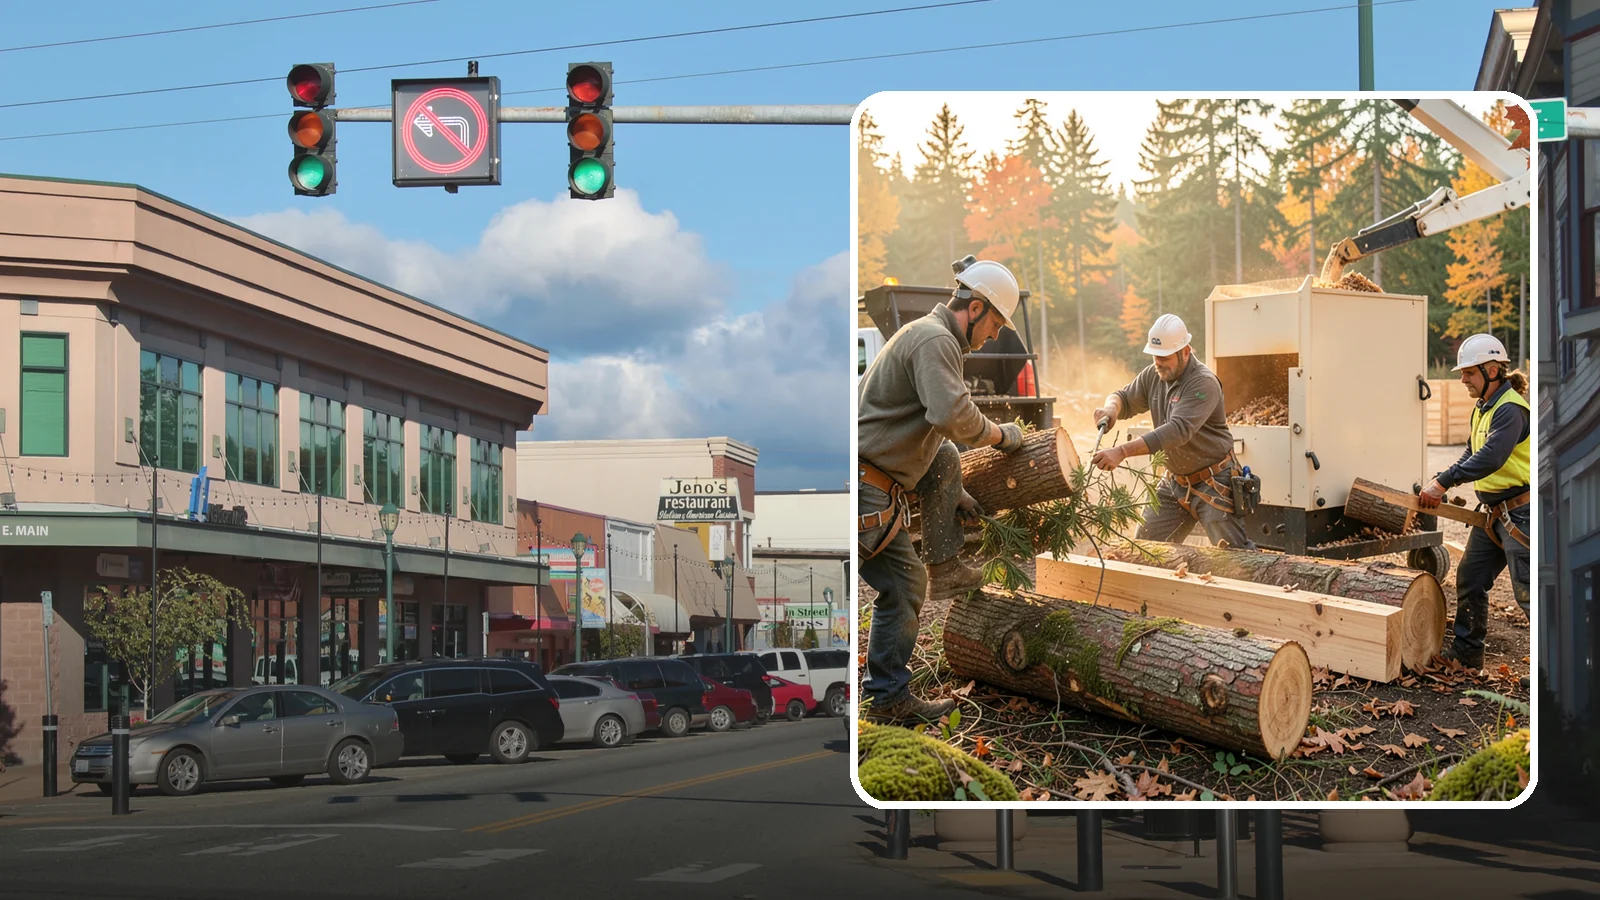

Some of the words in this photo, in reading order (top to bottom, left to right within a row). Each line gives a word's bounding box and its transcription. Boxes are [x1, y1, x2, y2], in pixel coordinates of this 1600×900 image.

[670, 480, 728, 494] Jeno's
[665, 496, 731, 509] restaurant
[658, 510, 681, 519] Italian
[686, 509, 714, 519] American
[715, 510, 738, 519] Cuisine
[2, 525, 13, 536] E.
[15, 525, 49, 536] MAIN
[797, 607, 828, 616] Street
[790, 619, 824, 627] lass
